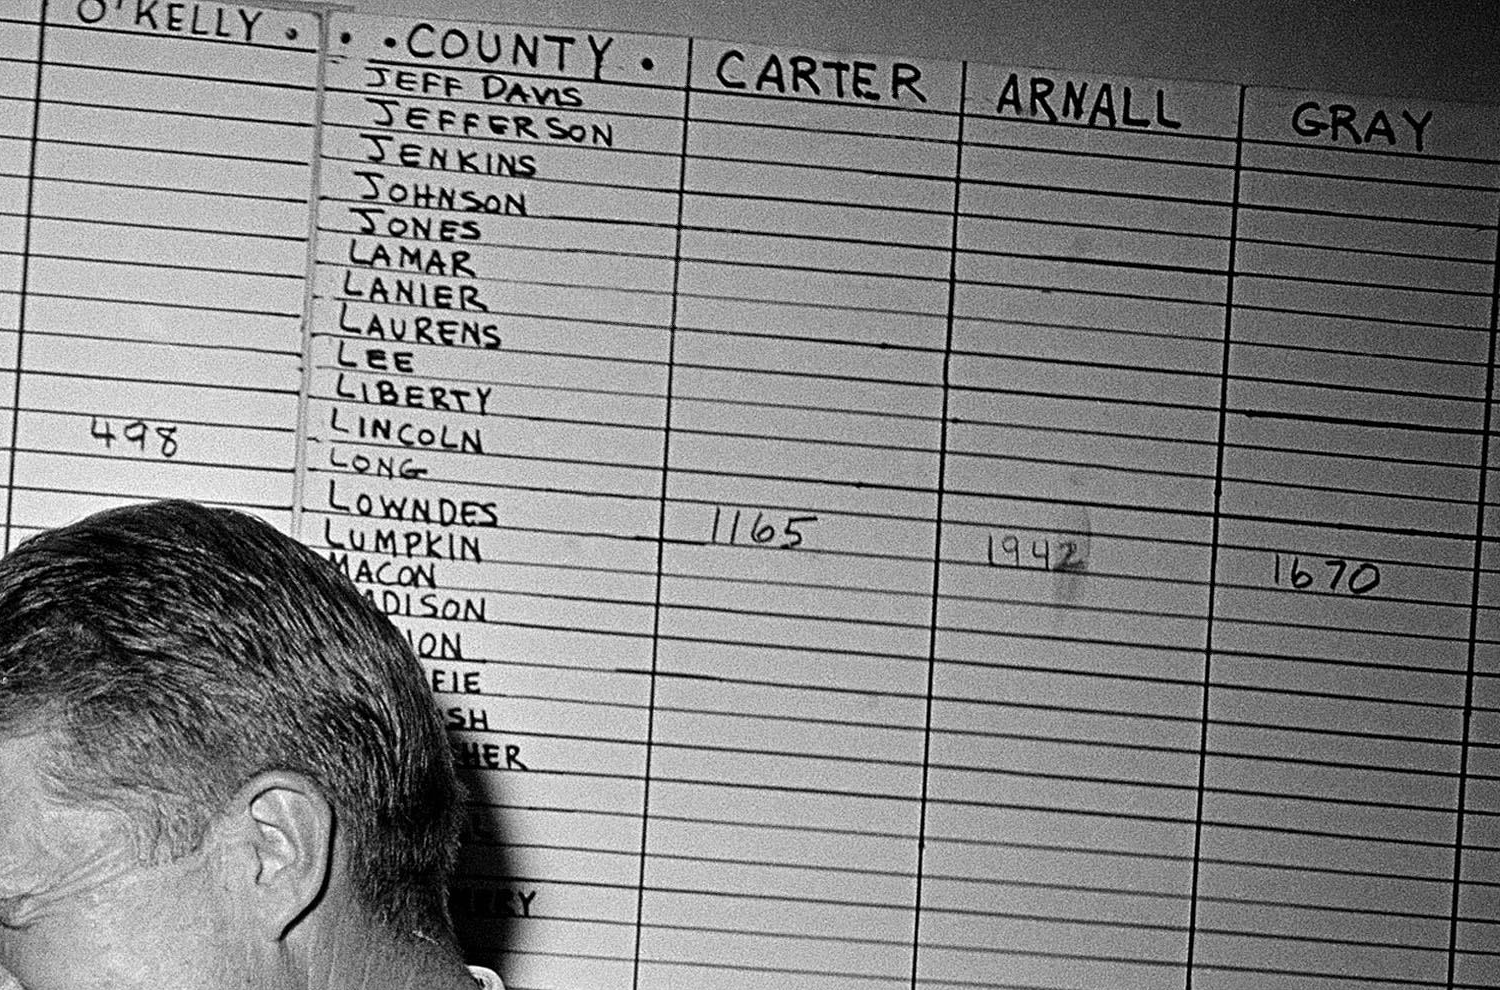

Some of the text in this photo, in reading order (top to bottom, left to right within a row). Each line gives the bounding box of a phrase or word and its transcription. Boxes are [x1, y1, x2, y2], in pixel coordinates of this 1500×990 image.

[406, 23, 614, 81] COUNTY
[365, 66, 583, 108] JEFF DAVIS
[715, 50, 927, 103] CARTER
[365, 98, 613, 148] JEFFERSON
[996, 73, 1182, 129] ARNALL
[1291, 102, 1433, 152] GRAY
[360, 133, 537, 179] JENKINS
[354, 171, 528, 217] JOHNSON
[349, 207, 482, 242] JONES
[349, 238, 477, 279] LAMAR
[343, 270, 489, 312] LANIER
[340, 302, 502, 350] LAURENS
[337, 341, 414, 373] LEE
[337, 373, 492, 416] LIBERTY
[89, 416, 179, 457] 498
[331, 408, 485, 454] LINCOLN
[329, 447, 428, 479] LONG
[329, 480, 499, 527] LOWNDES
[325, 518, 483, 563] LUMPKIN
[711, 506, 819, 549] 1165
[1273, 554, 1381, 595] 1670
